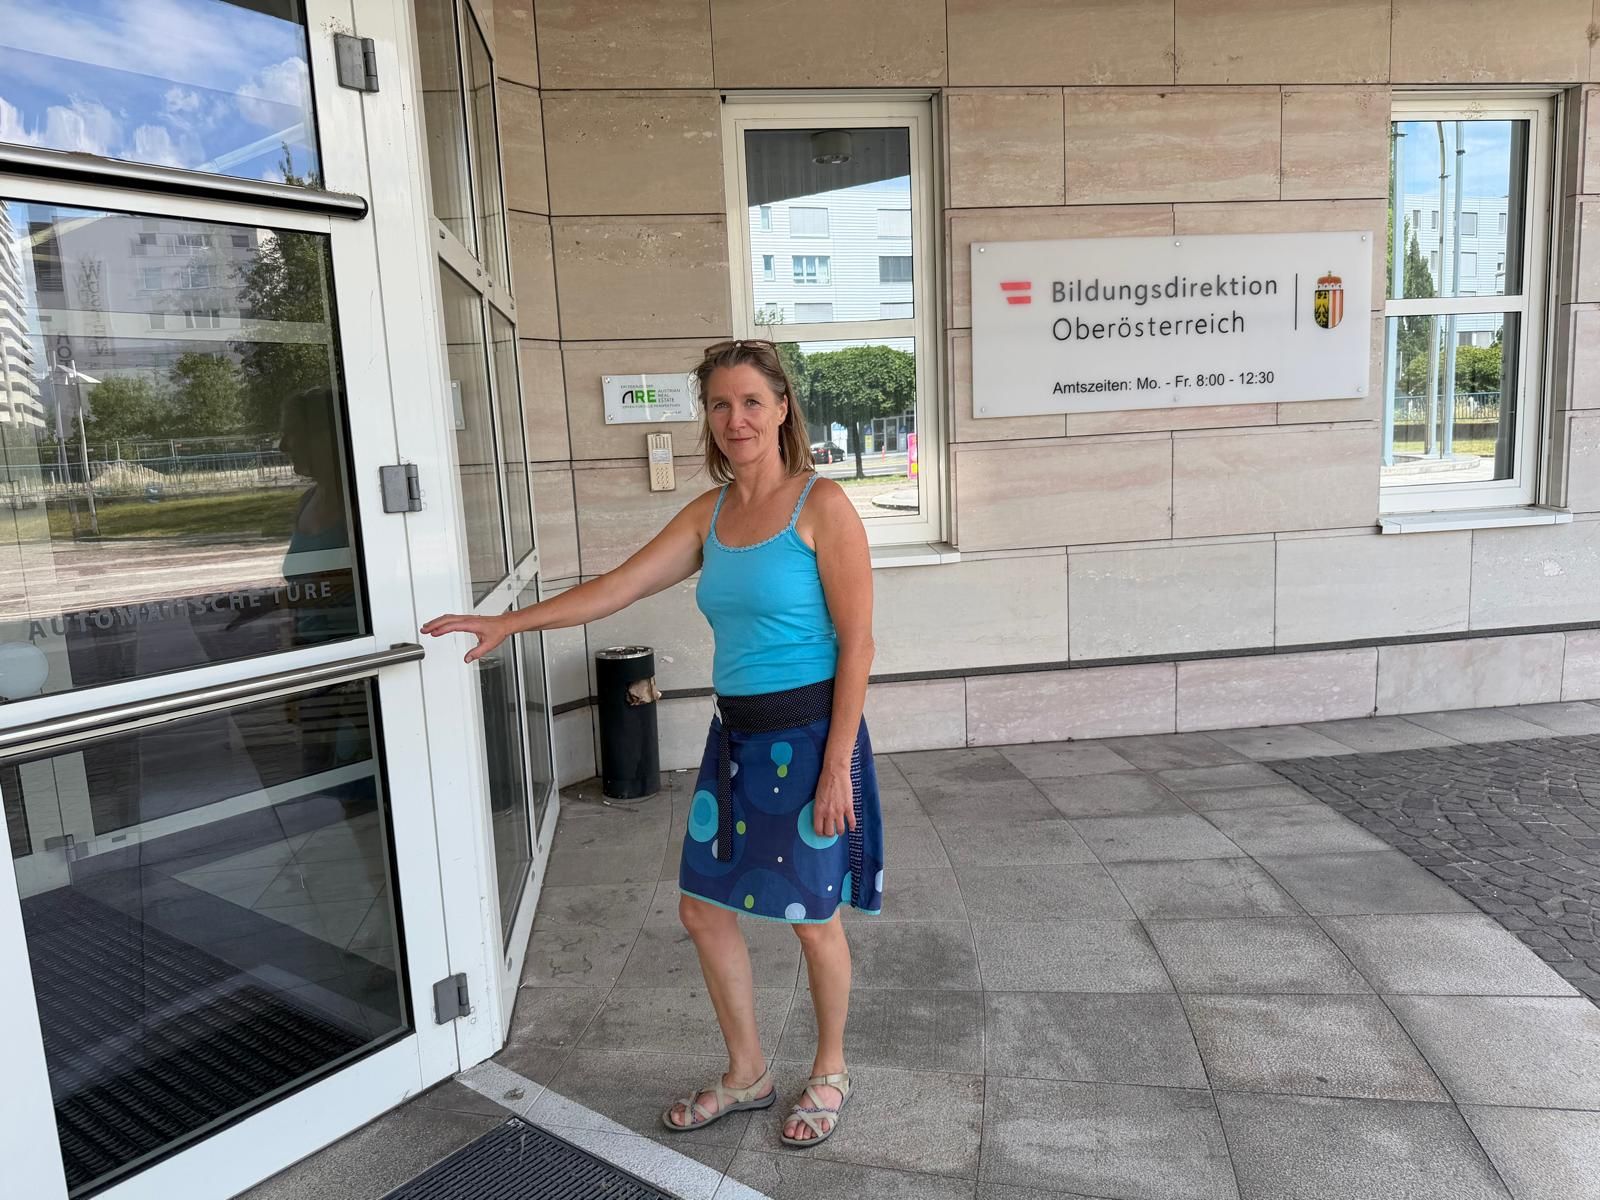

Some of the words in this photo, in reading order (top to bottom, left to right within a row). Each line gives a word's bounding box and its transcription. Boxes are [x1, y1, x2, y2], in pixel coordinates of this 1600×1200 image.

[1052, 274, 1278, 305] Bildungsdirektion
[1052, 310, 1246, 342] Oberösterreich
[1052, 376, 1133, 395] Amtszeiten:
[1136, 376, 1161, 390] Mo.
[1175, 375, 1192, 389] Fr.
[1196, 373, 1225, 388] 8:00
[1238, 371, 1275, 386] 12:30
[28, 590, 262, 641] AUTOMATISCHE
[271, 580, 333, 605] TÜRE
